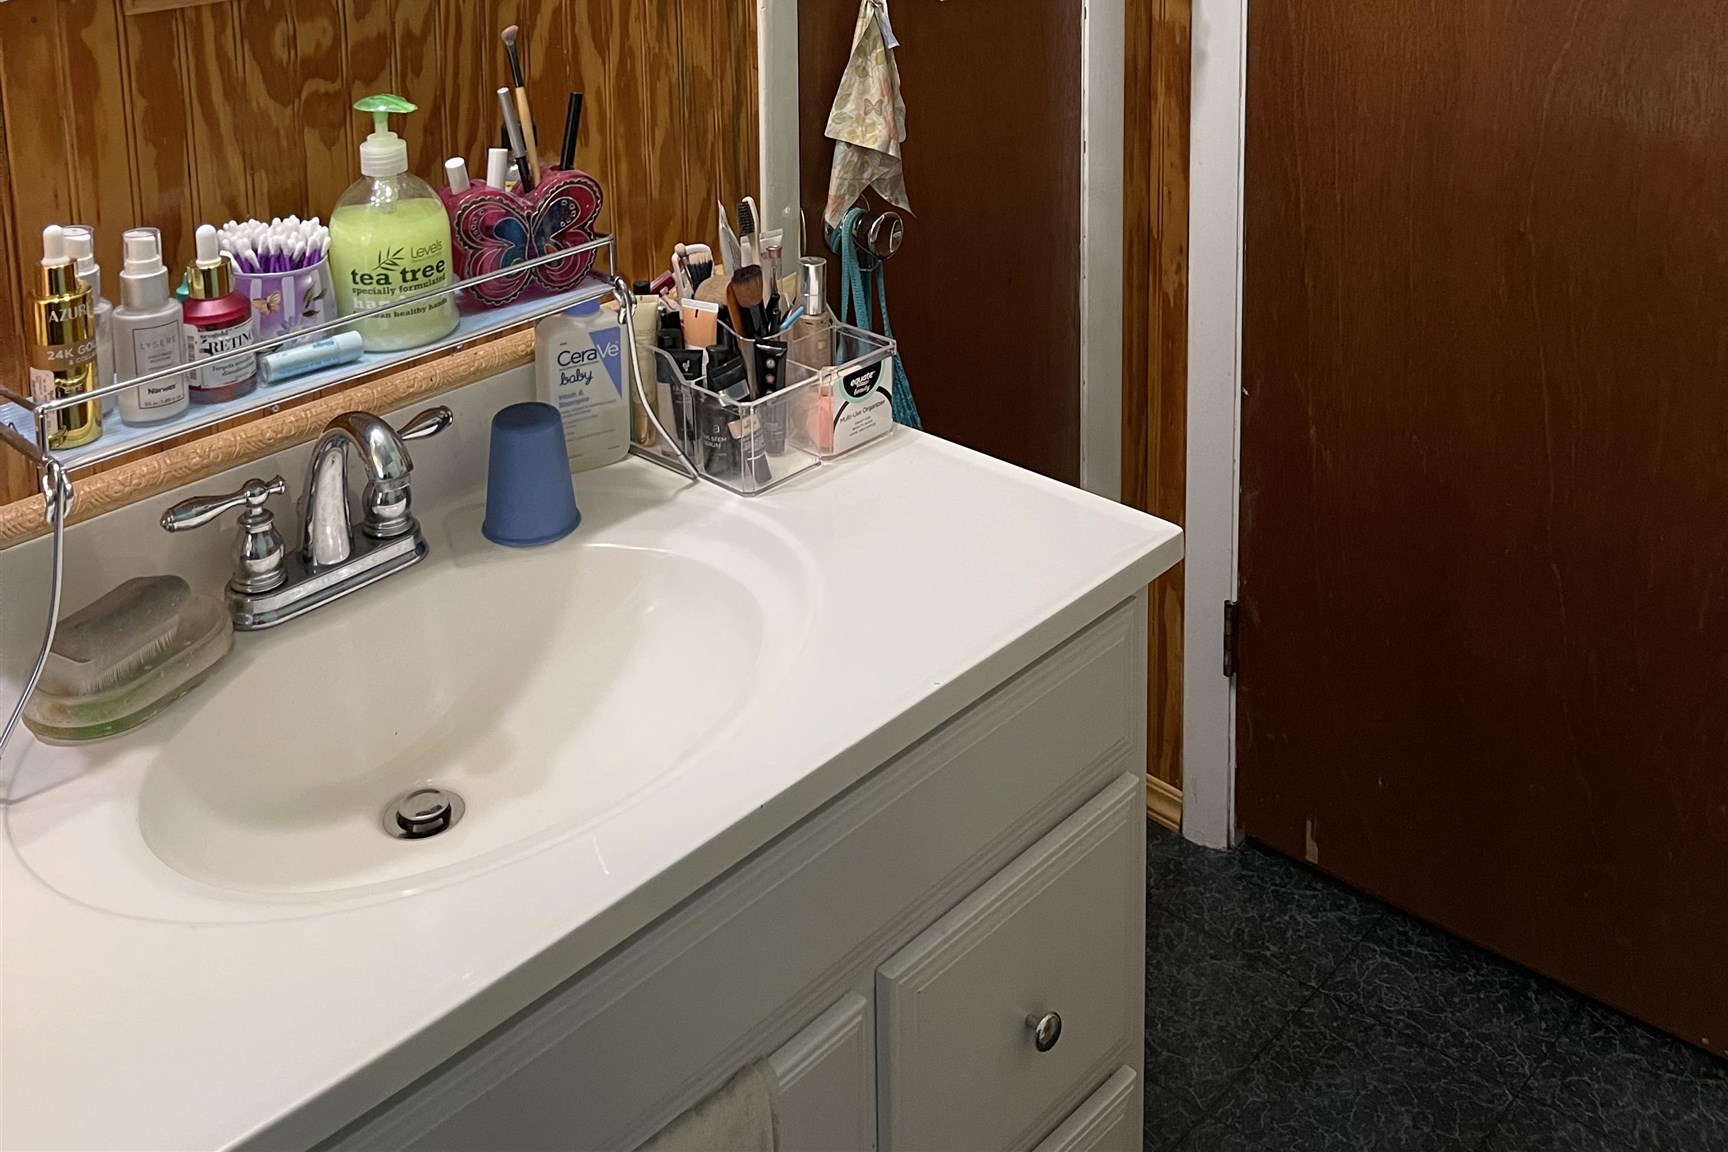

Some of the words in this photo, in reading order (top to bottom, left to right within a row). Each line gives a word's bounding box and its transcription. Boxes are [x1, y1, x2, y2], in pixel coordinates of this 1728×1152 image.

[351, 268, 392, 286] tea
[400, 259, 445, 284] tree
[352, 286, 396, 297] specially
[400, 273, 446, 294] formulated
[394, 306, 426, 318] healthy
[428, 297, 448, 311] hands
[47, 348, 74, 361] 24K
[557, 342, 619, 367] CeraVe
[559, 368, 594, 386] baby
[850, 371, 876, 386] equate
